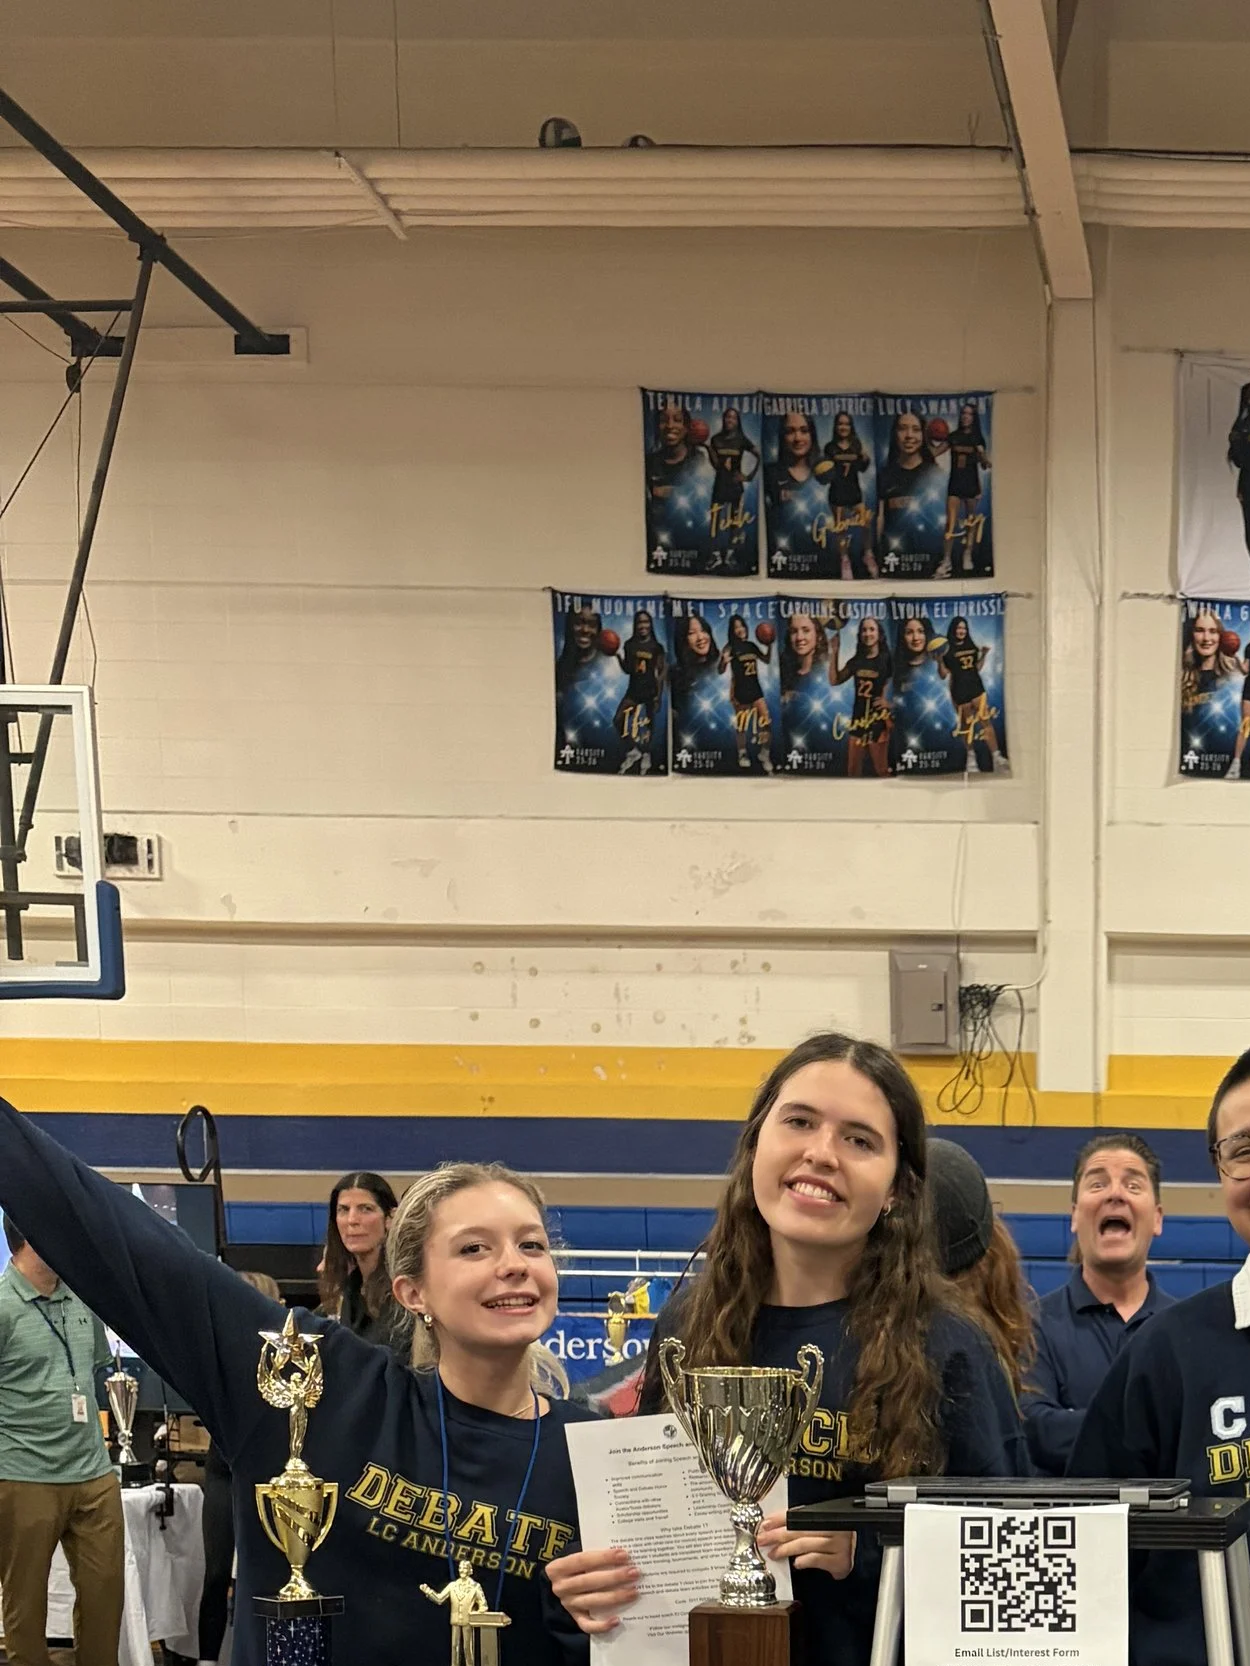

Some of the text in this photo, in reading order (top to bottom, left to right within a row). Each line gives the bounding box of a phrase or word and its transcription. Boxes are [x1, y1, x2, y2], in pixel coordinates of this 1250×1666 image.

[879, 396, 912, 416] LUCY
[718, 600, 776, 619] SPACE
[891, 601, 930, 620] LYDIA
[933, 600, 949, 618] EL
[1185, 601, 1233, 622] WILLA
[545, 1329, 651, 1361] derso
[632, 1441, 684, 1453] Anderson Speech
[344, 1461, 576, 1563] DEBATE
[366, 1516, 537, 1581] LC ANDERSON
[954, 1648, 1080, 1659] Email List/Interest Form
